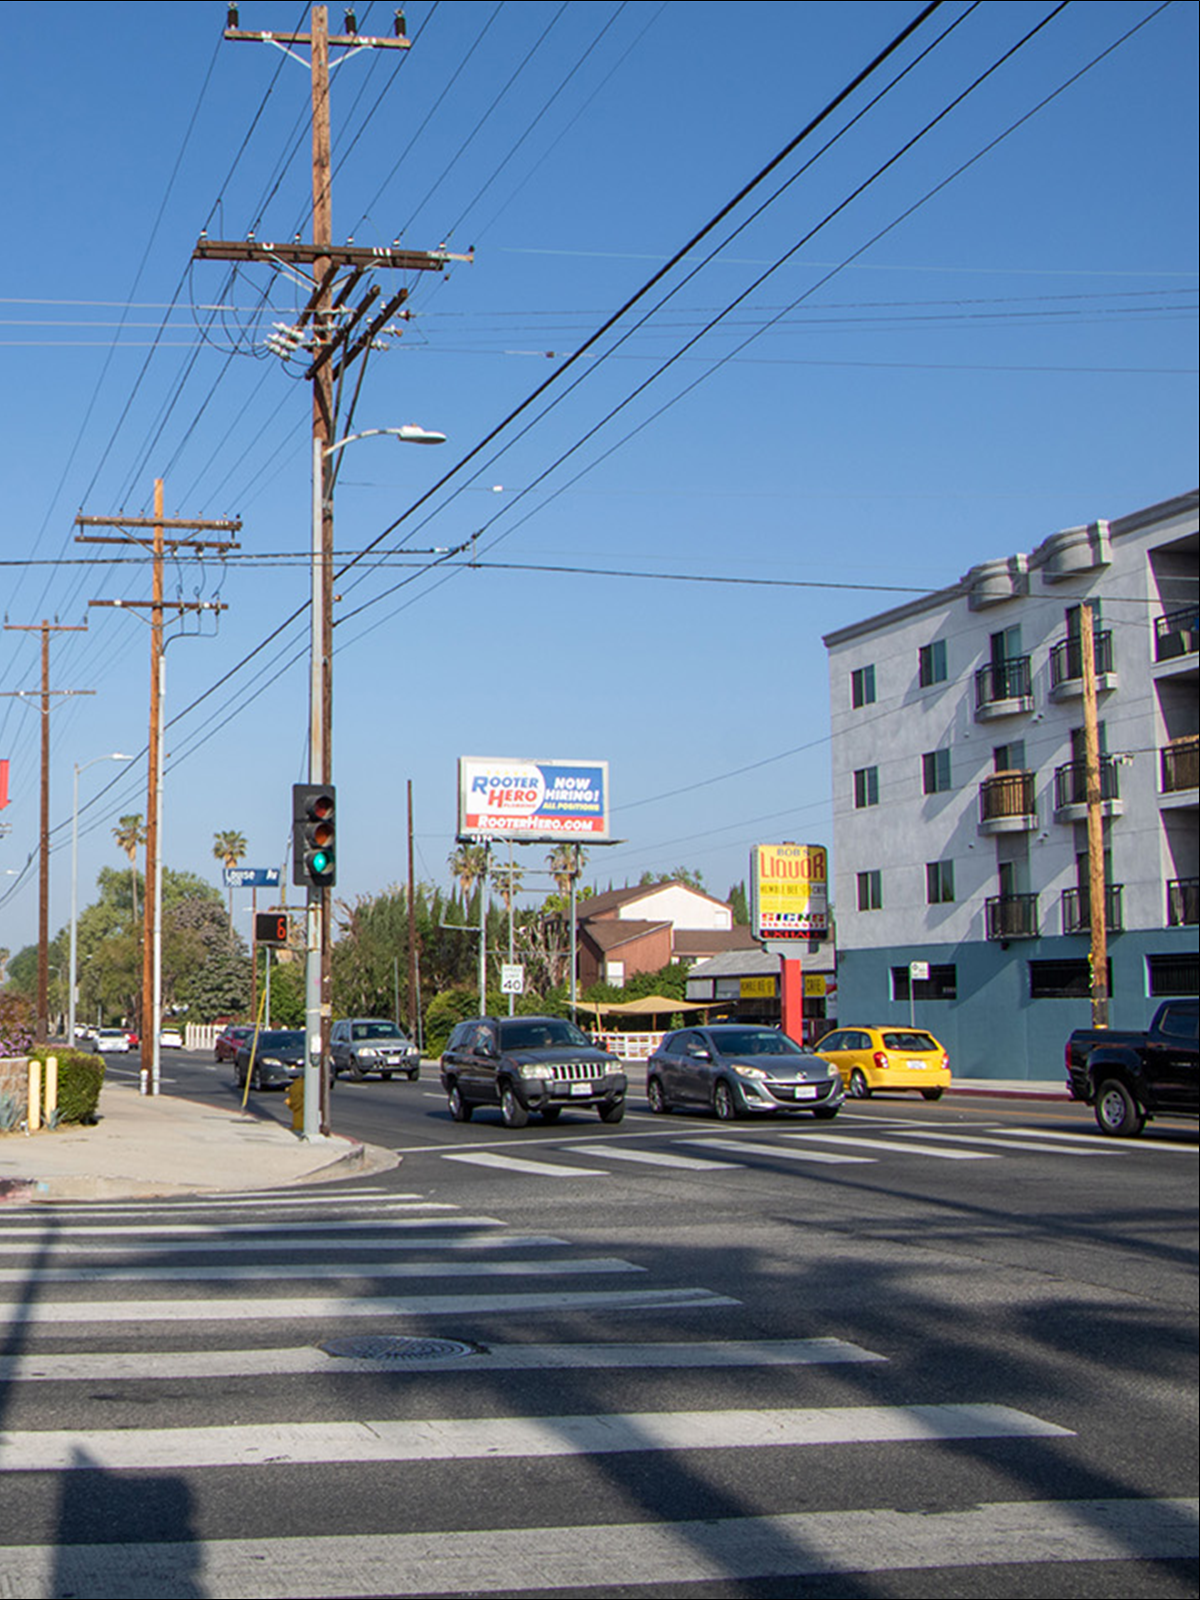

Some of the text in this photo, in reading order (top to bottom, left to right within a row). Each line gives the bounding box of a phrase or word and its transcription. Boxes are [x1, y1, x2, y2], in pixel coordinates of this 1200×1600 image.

[472, 776, 539, 794] ROOTER
[554, 777, 590, 790] NOW
[488, 789, 537, 808] HERO
[545, 790, 600, 802] HIRING!
[542, 802, 600, 811] ALL POSITIONS
[761, 852, 824, 878] LIQUOR
[277, 917, 287, 939] 6
[503, 980, 521, 990] 40
